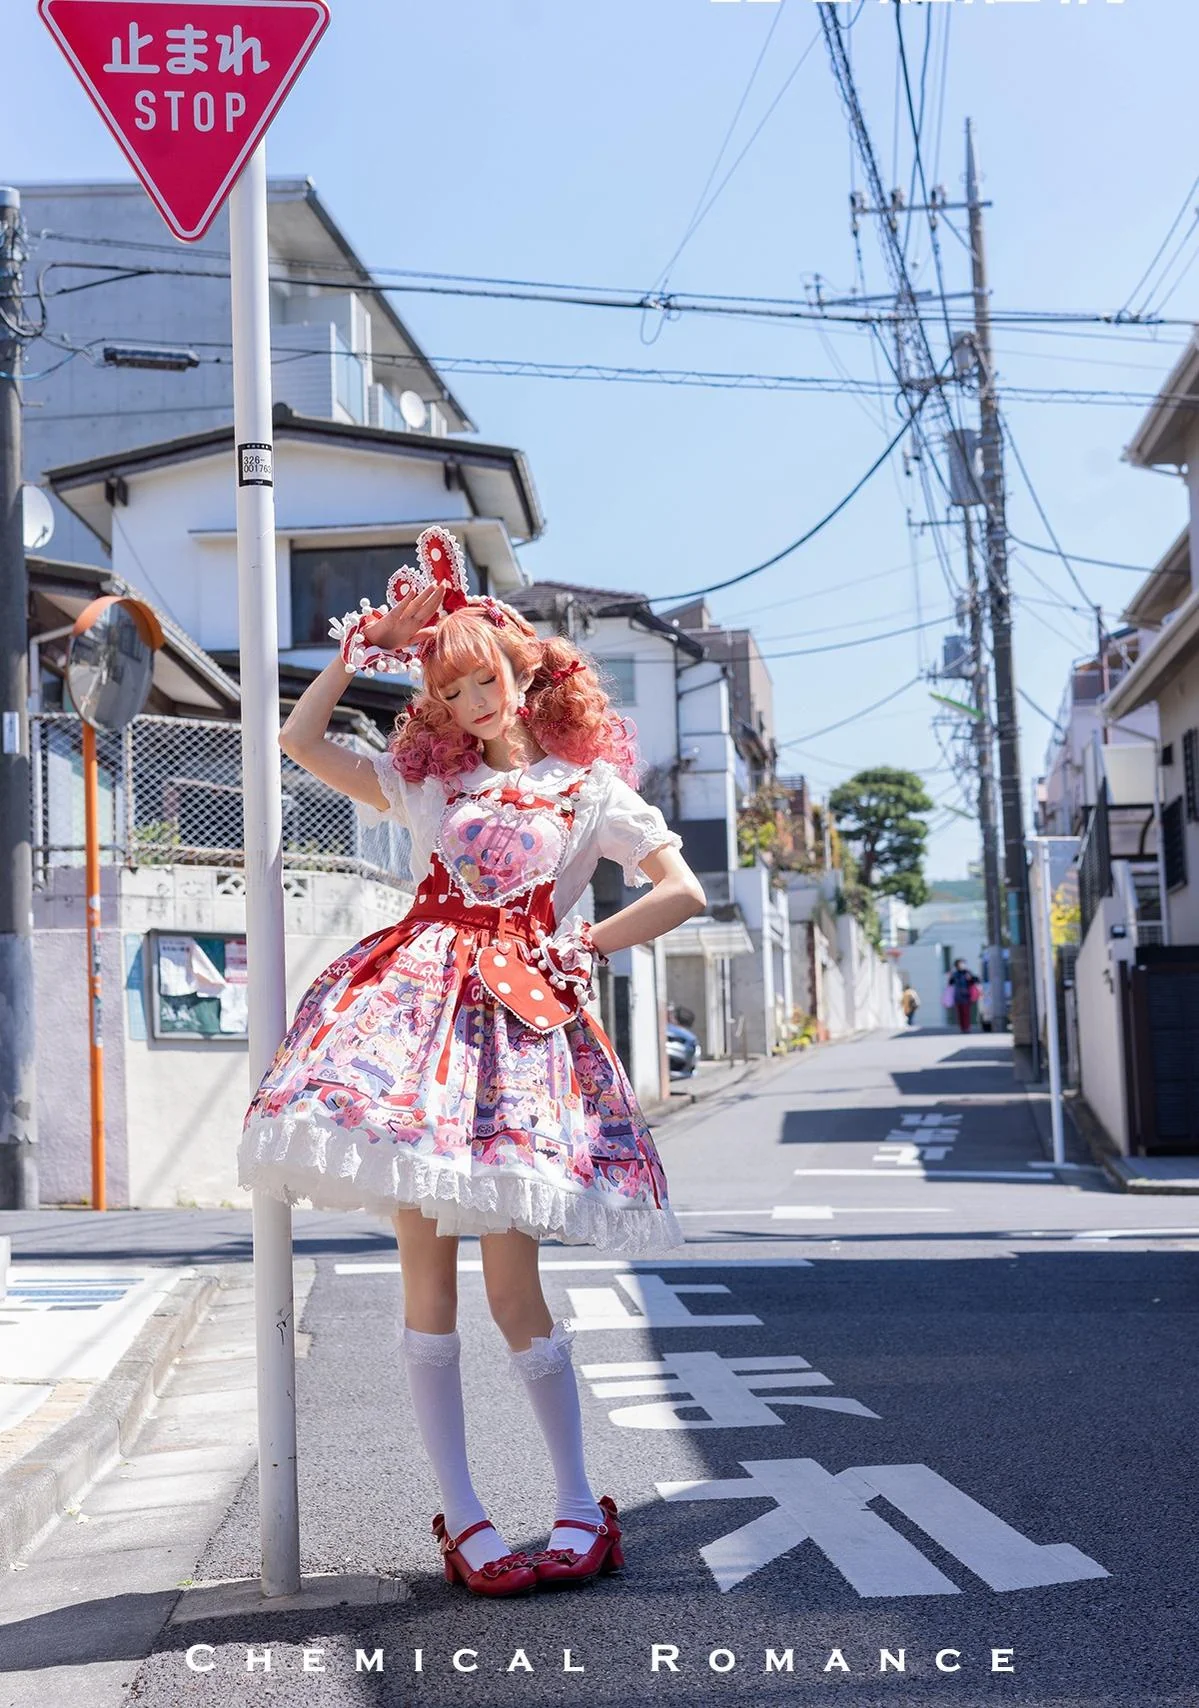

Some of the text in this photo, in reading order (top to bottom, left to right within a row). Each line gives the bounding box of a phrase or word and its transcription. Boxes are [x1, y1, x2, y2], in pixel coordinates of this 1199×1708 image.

[103, 22, 270, 75] 止まれ
[134, 90, 246, 133] STOP
[566, 1274, 1113, 1599] 止まれ
